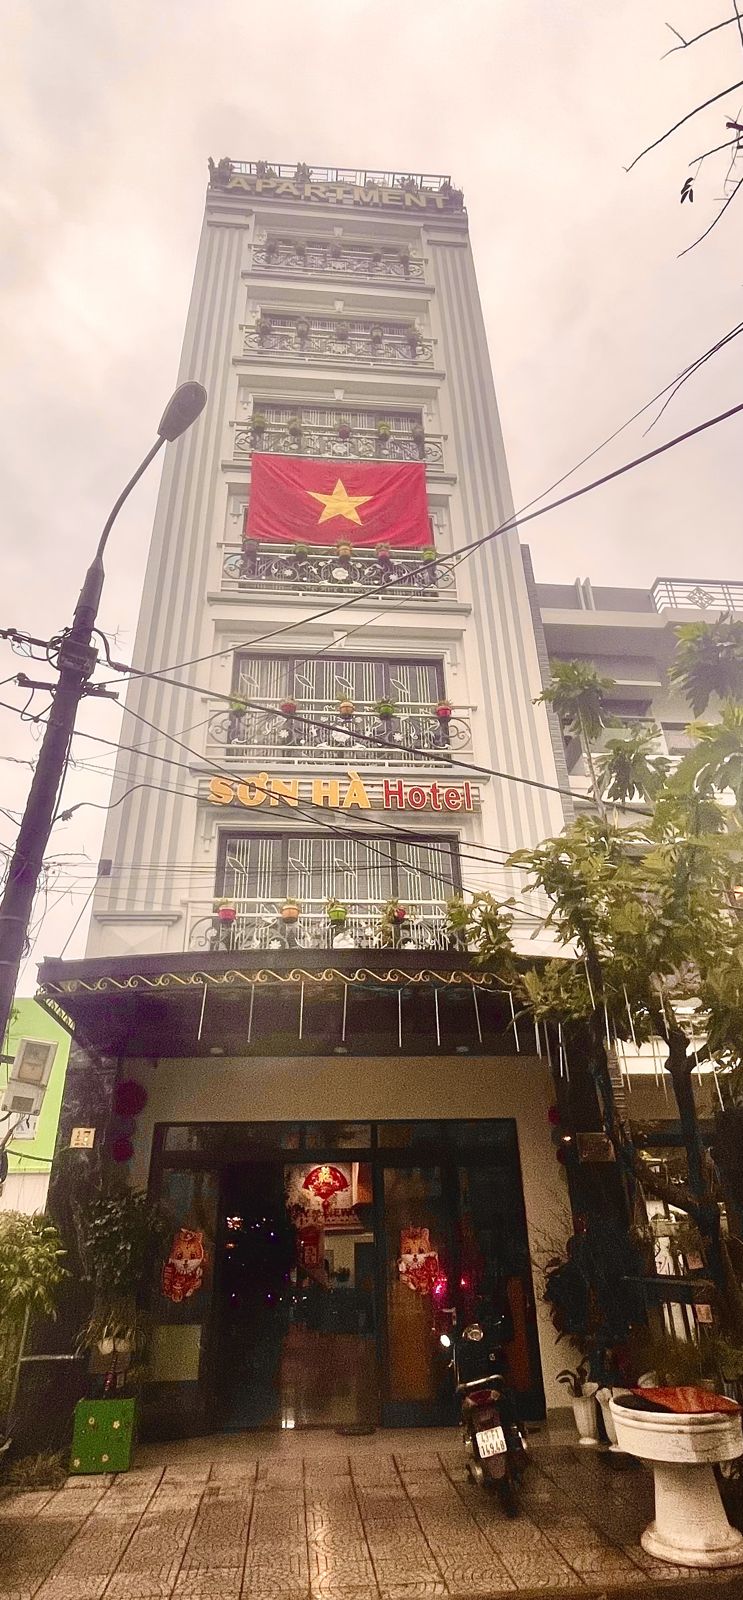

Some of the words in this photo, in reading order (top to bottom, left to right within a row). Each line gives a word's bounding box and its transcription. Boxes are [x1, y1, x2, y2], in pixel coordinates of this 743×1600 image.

[227, 176, 450, 209] APARTMENT
[207, 771, 300, 807] SƠN
[311, 770, 371, 809] HÀ
[382, 778, 474, 811] Hotel
